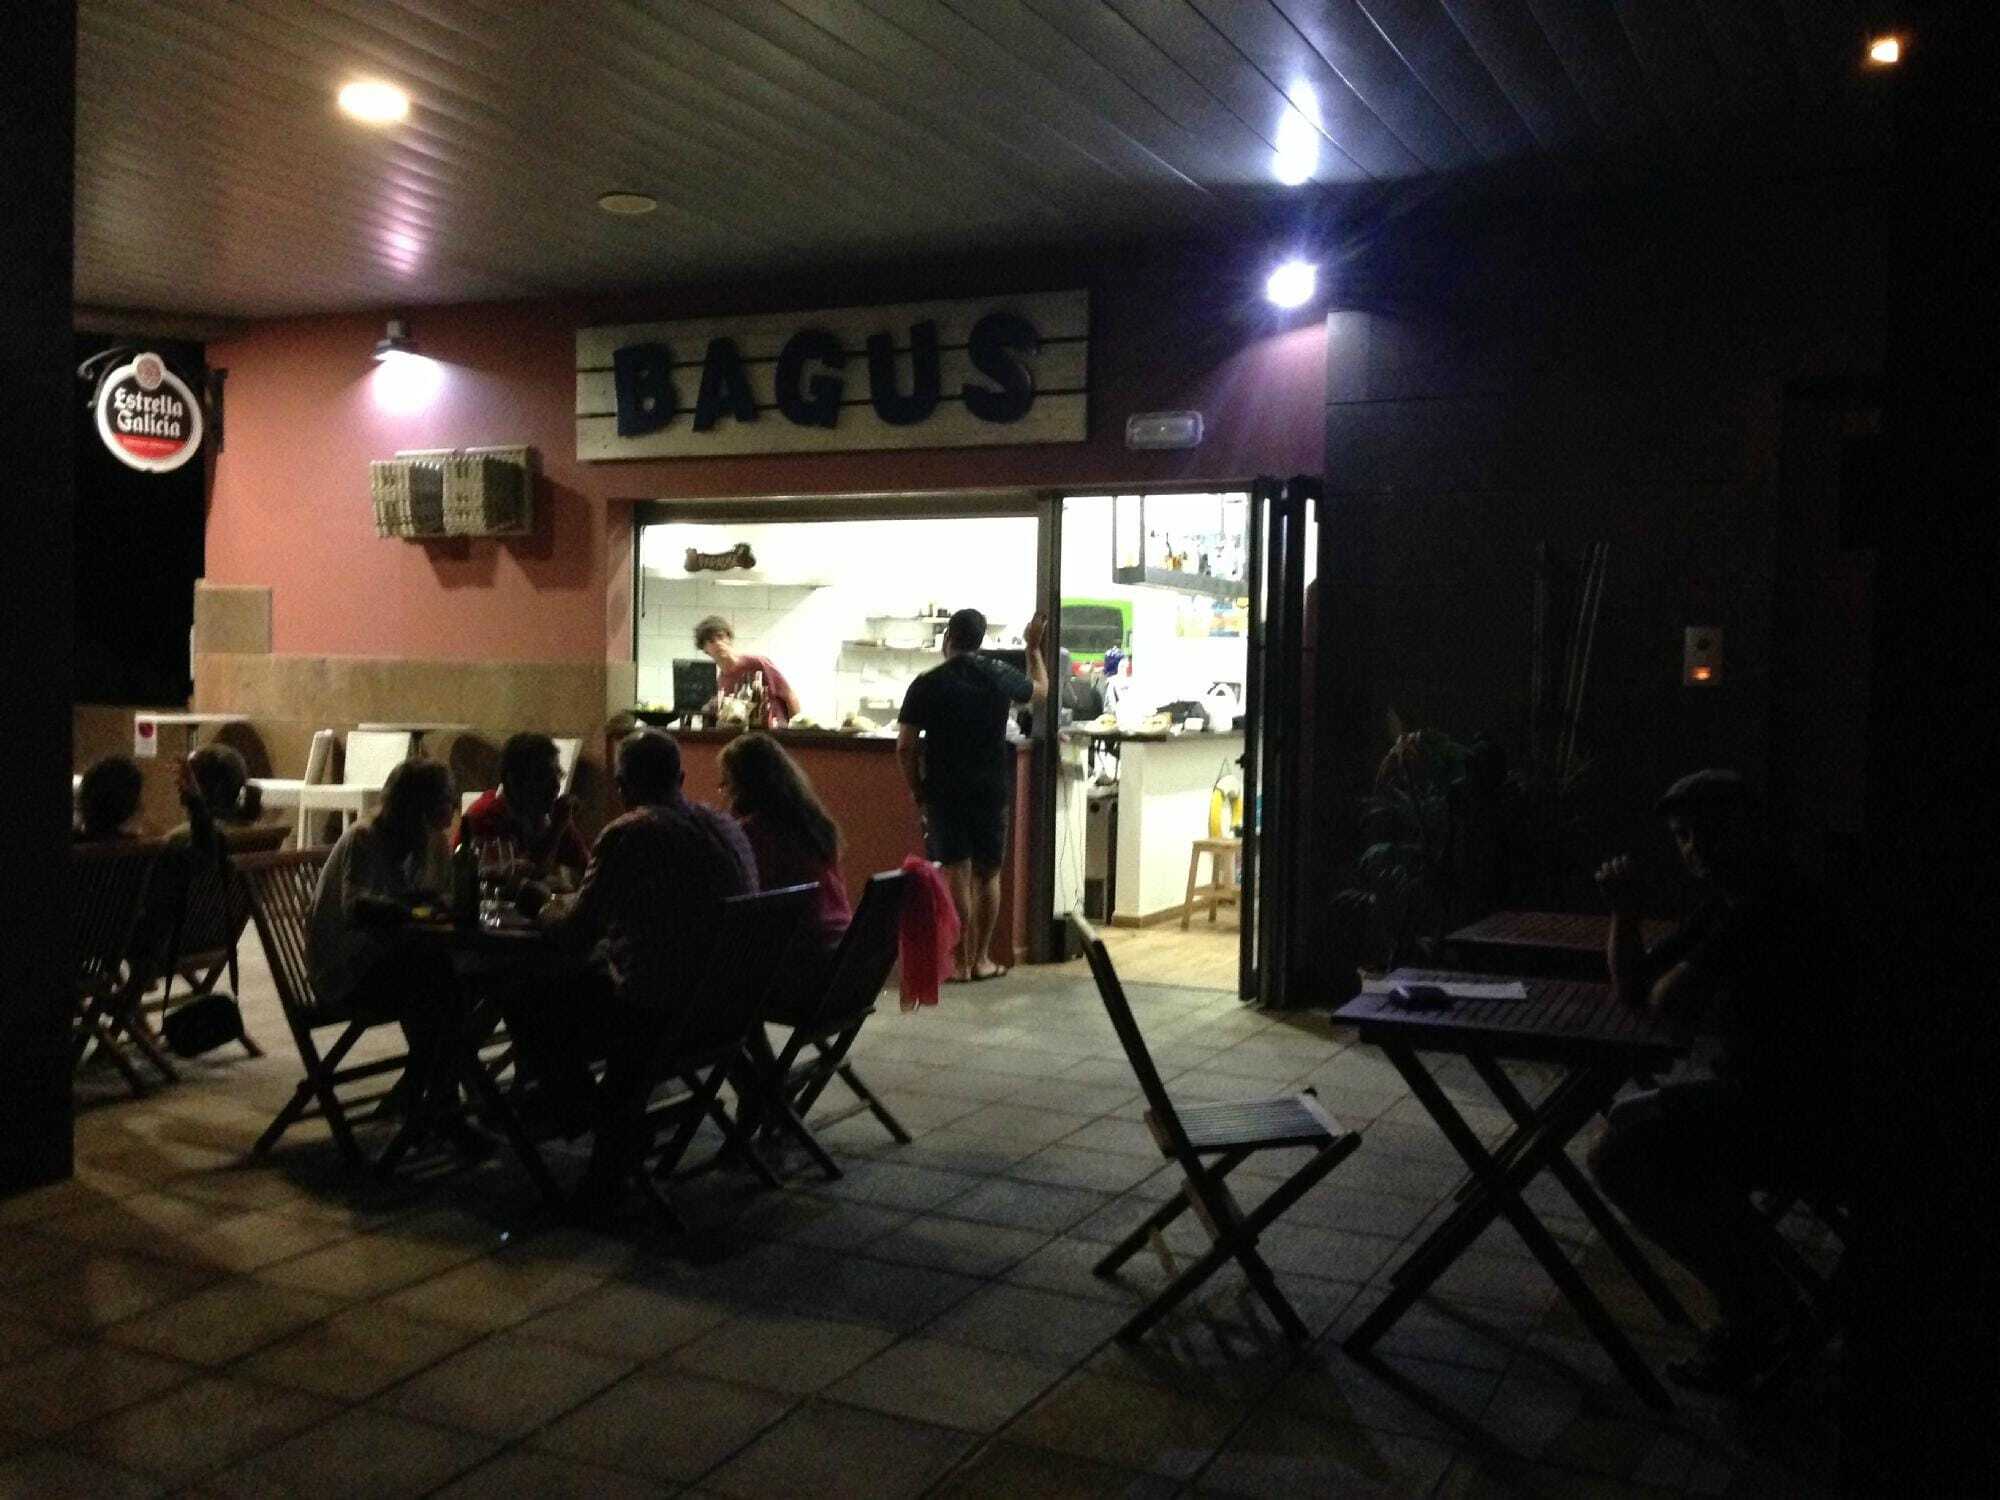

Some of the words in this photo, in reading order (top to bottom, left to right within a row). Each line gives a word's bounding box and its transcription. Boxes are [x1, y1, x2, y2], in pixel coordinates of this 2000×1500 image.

[614, 313, 1040, 437] BAGUS
[114, 387, 183, 417] Estrella
[117, 410, 181, 439] Galicia
